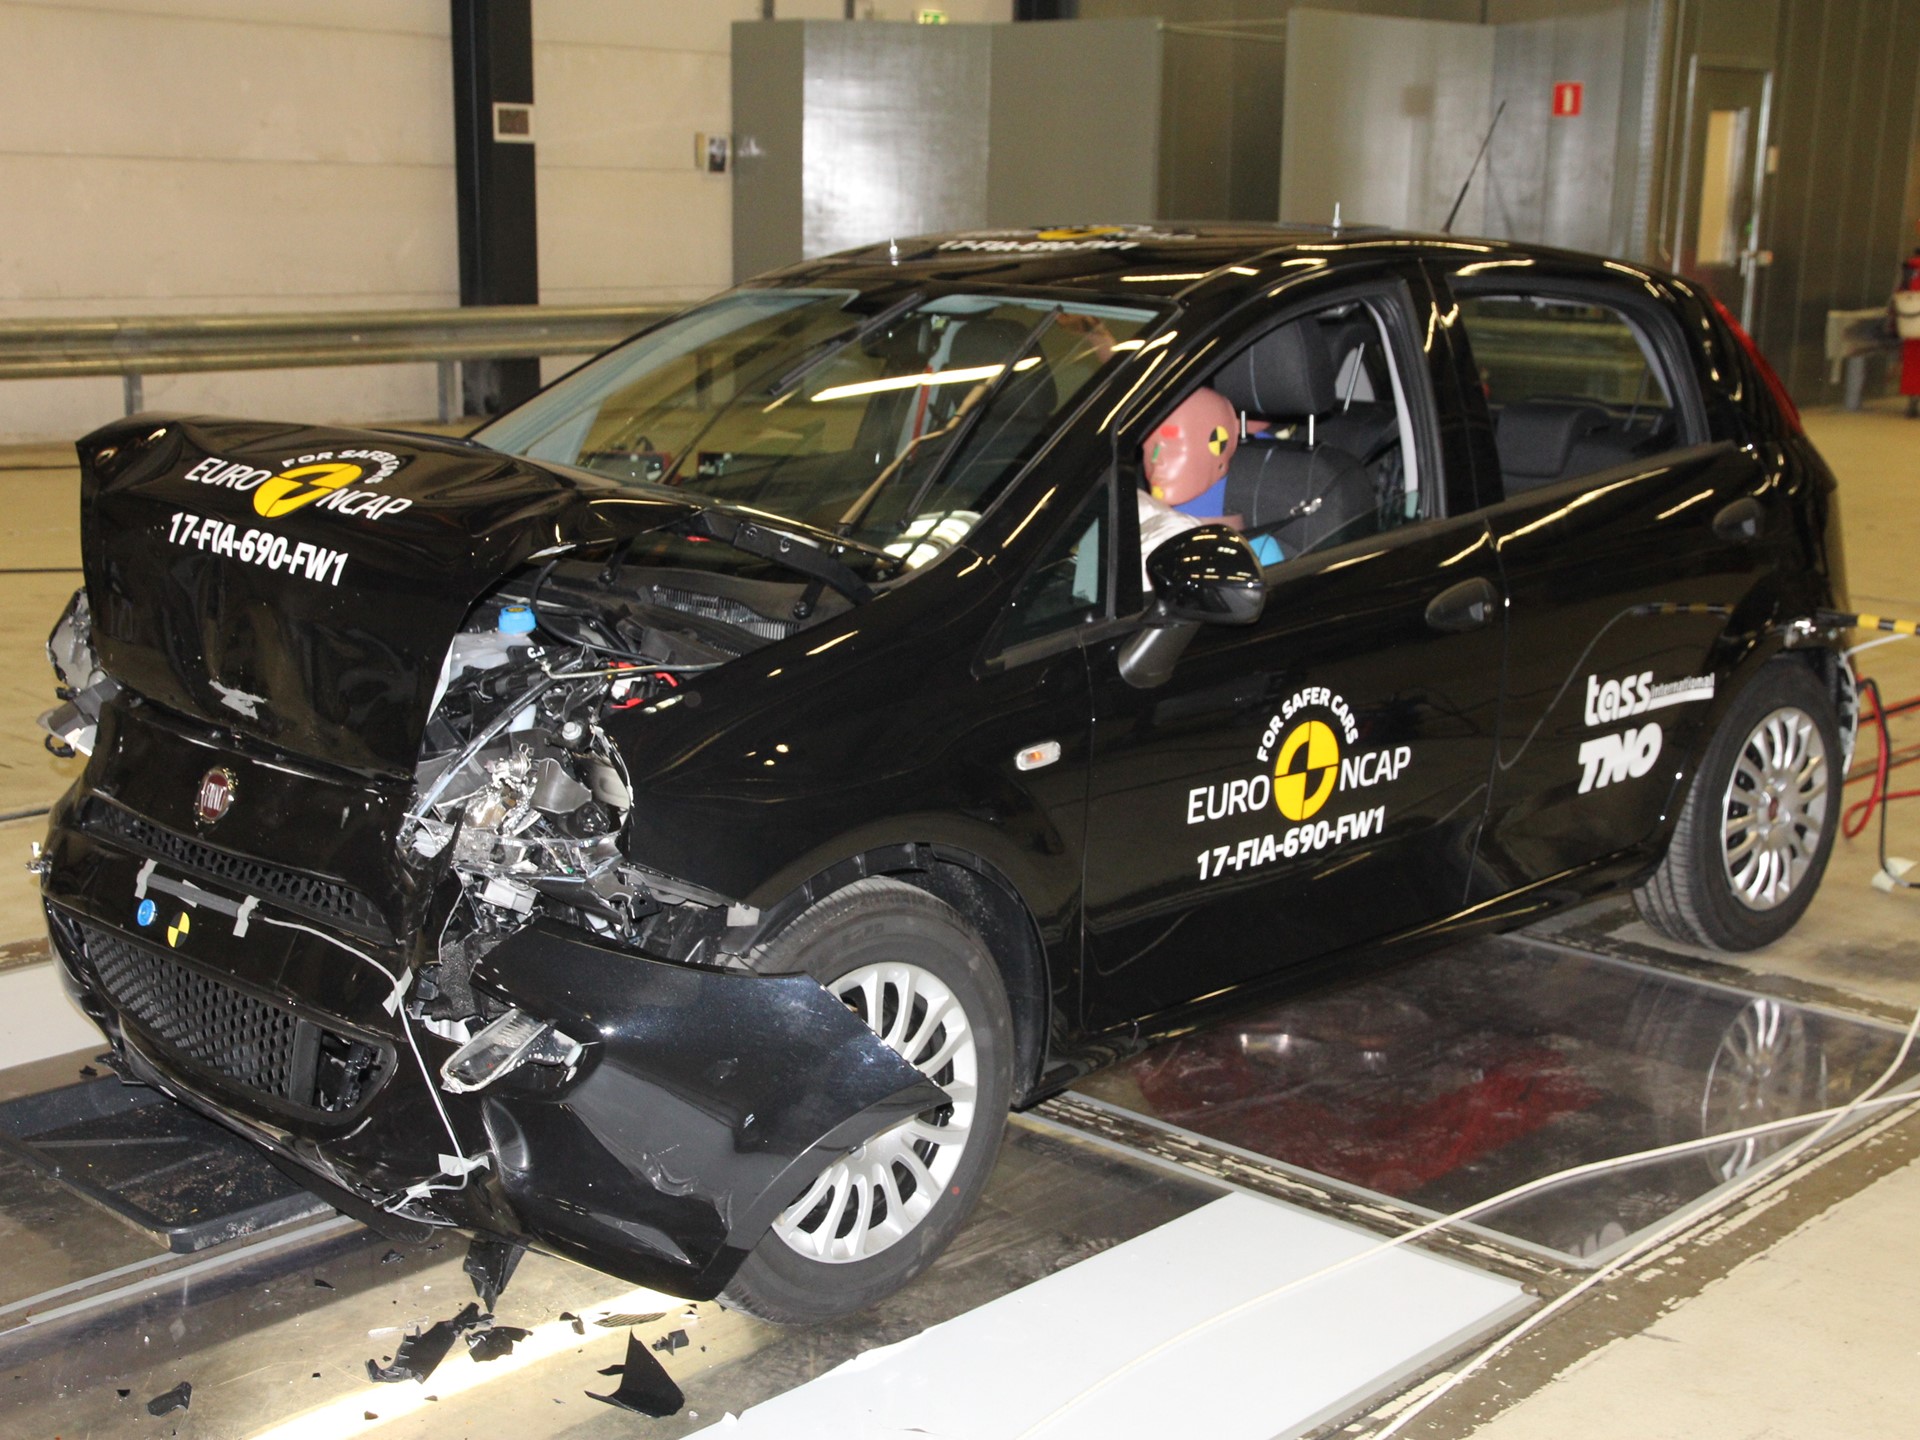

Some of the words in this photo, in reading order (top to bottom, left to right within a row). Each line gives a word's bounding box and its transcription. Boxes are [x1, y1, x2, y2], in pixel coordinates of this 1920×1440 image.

[184, 457, 272, 491] EURO
[315, 488, 413, 520] NCAP
[282, 452, 334, 468] FOR
[168, 512, 349, 587] 17-FIA-690-FW1
[1257, 715, 1284, 762] FOR
[1282, 687, 1331, 720] SAFER
[1330, 695, 1359, 744] CARS
[1578, 722, 1663, 794] TNO
[1187, 775, 1271, 824] EURO
[1339, 746, 1412, 791] NCAP
[1197, 805, 1385, 881] 17-FIA-690-FW1
